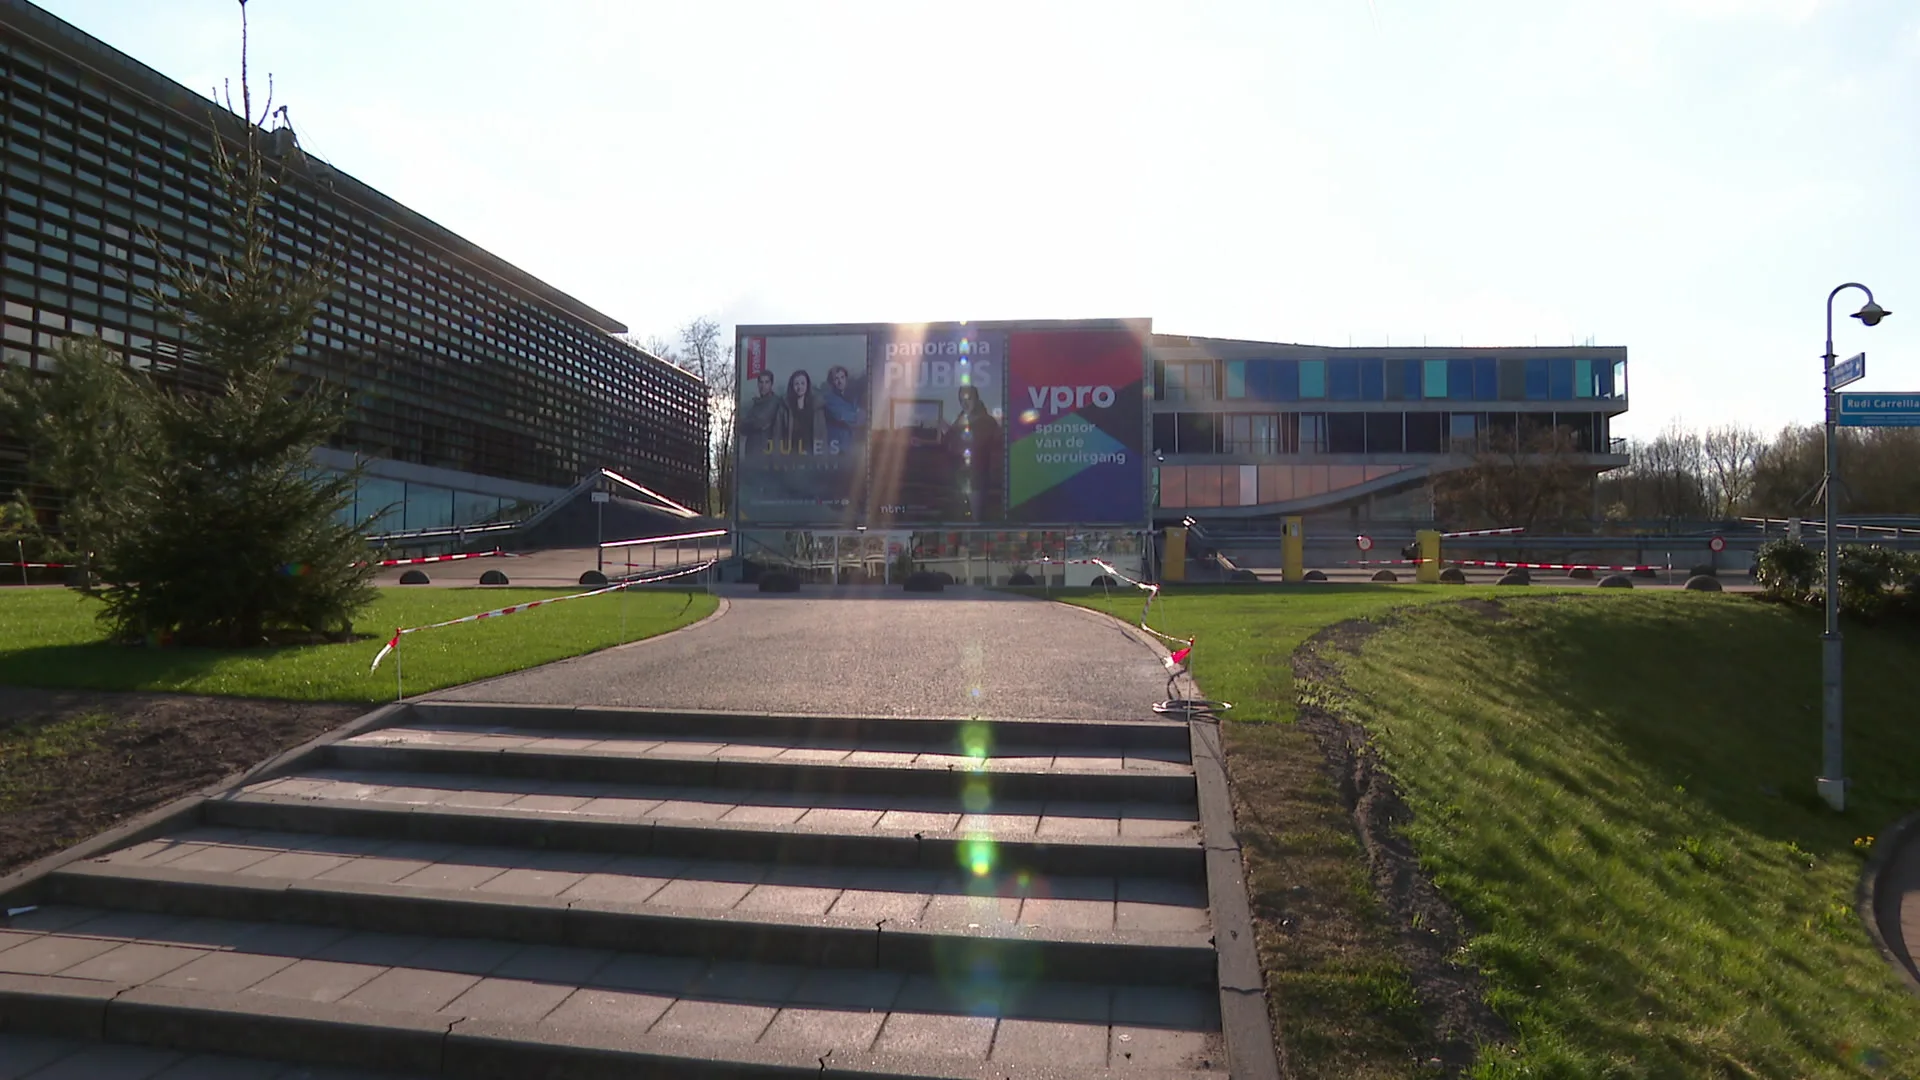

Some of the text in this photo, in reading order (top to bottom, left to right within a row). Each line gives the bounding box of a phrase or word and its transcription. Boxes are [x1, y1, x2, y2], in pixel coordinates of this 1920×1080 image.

[885, 340, 990, 360] panorama
[1028, 385, 1116, 415] vpro
[1847, 399, 1870, 408] Rudi
[1035, 423, 1096, 435] sponsor
[763, 439, 840, 455] JULES
[1035, 436, 1084, 448] van de
[1035, 450, 1126, 465] vooruitgang
